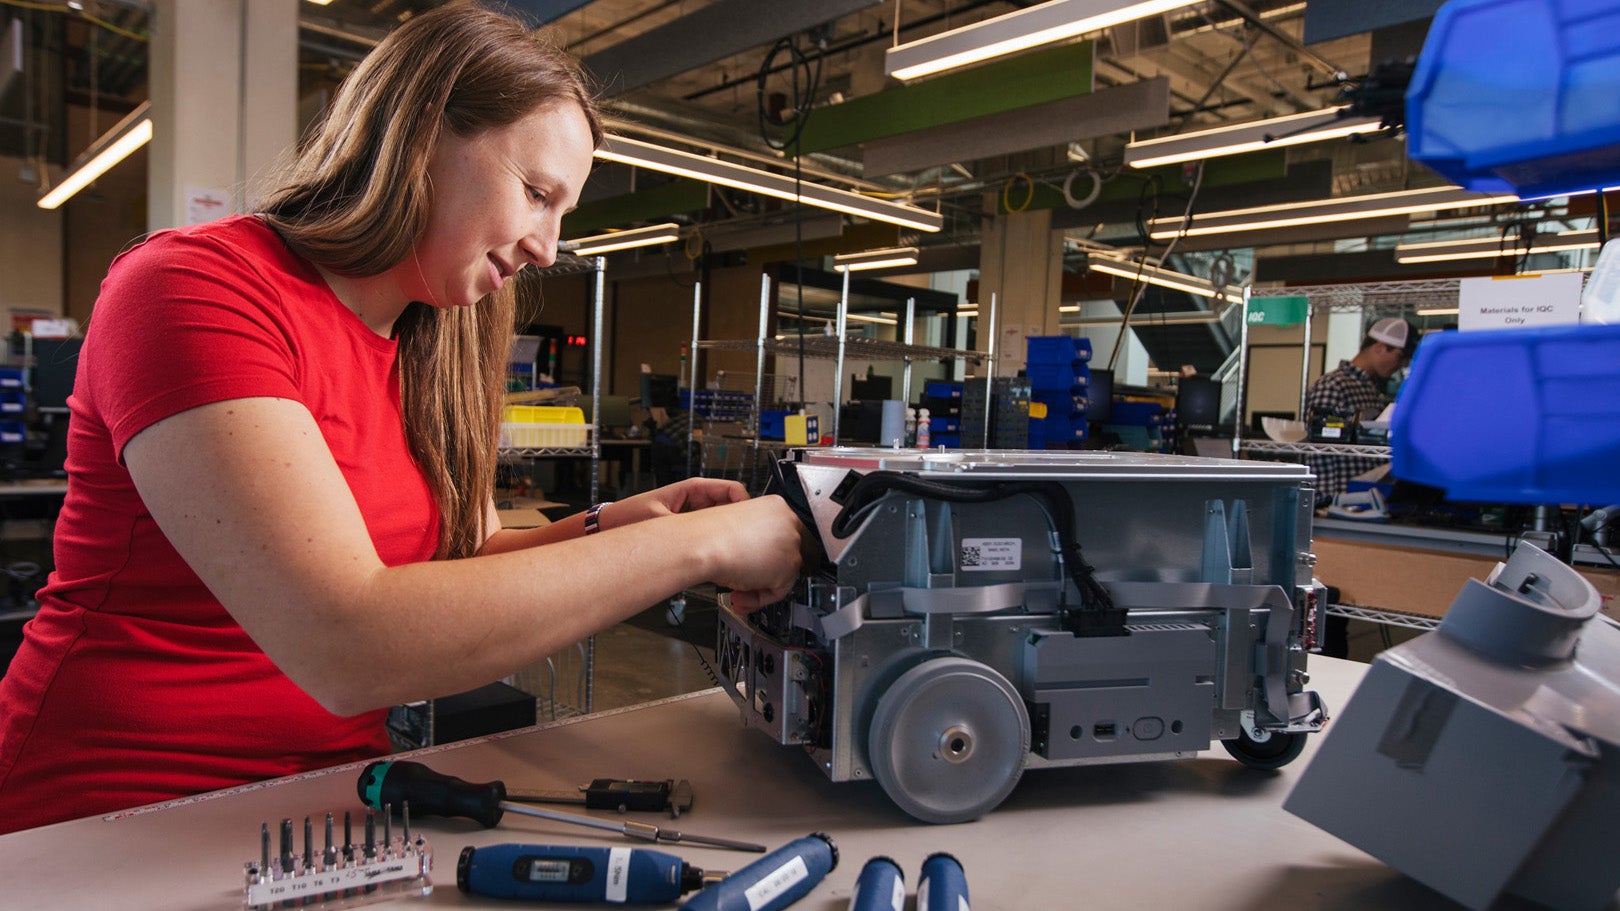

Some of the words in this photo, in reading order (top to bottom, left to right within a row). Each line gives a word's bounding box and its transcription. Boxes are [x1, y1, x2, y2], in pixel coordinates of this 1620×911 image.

[1536, 305, 1554, 313] IQC
[1248, 311, 1265, 322] IQC
[1504, 317, 1526, 325] Only
[270, 886, 285, 894] T20
[292, 882, 307, 890] T10
